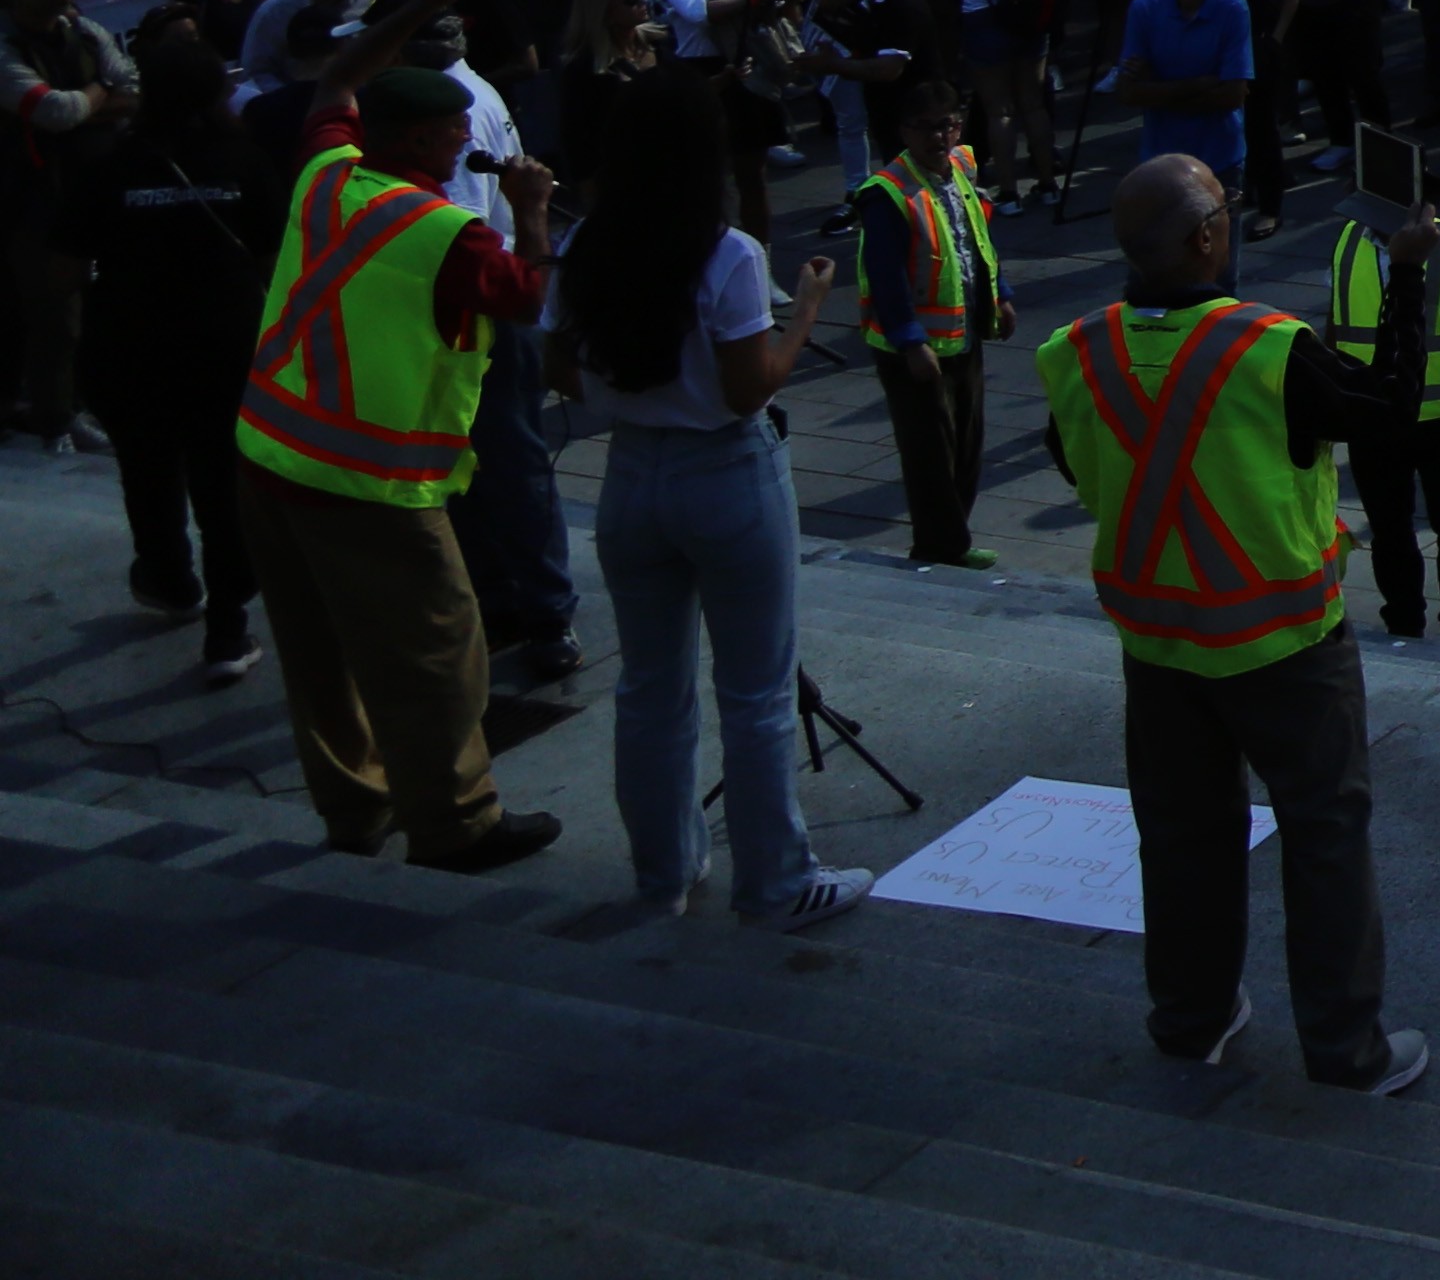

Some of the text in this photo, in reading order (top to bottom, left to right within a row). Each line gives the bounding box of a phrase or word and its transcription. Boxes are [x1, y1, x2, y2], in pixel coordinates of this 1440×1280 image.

[977, 805, 1054, 840] US
[935, 839, 1134, 889] PROTECT US
[912, 869, 1001, 899] MEANT
[1016, 883, 1063, 905] ARE
